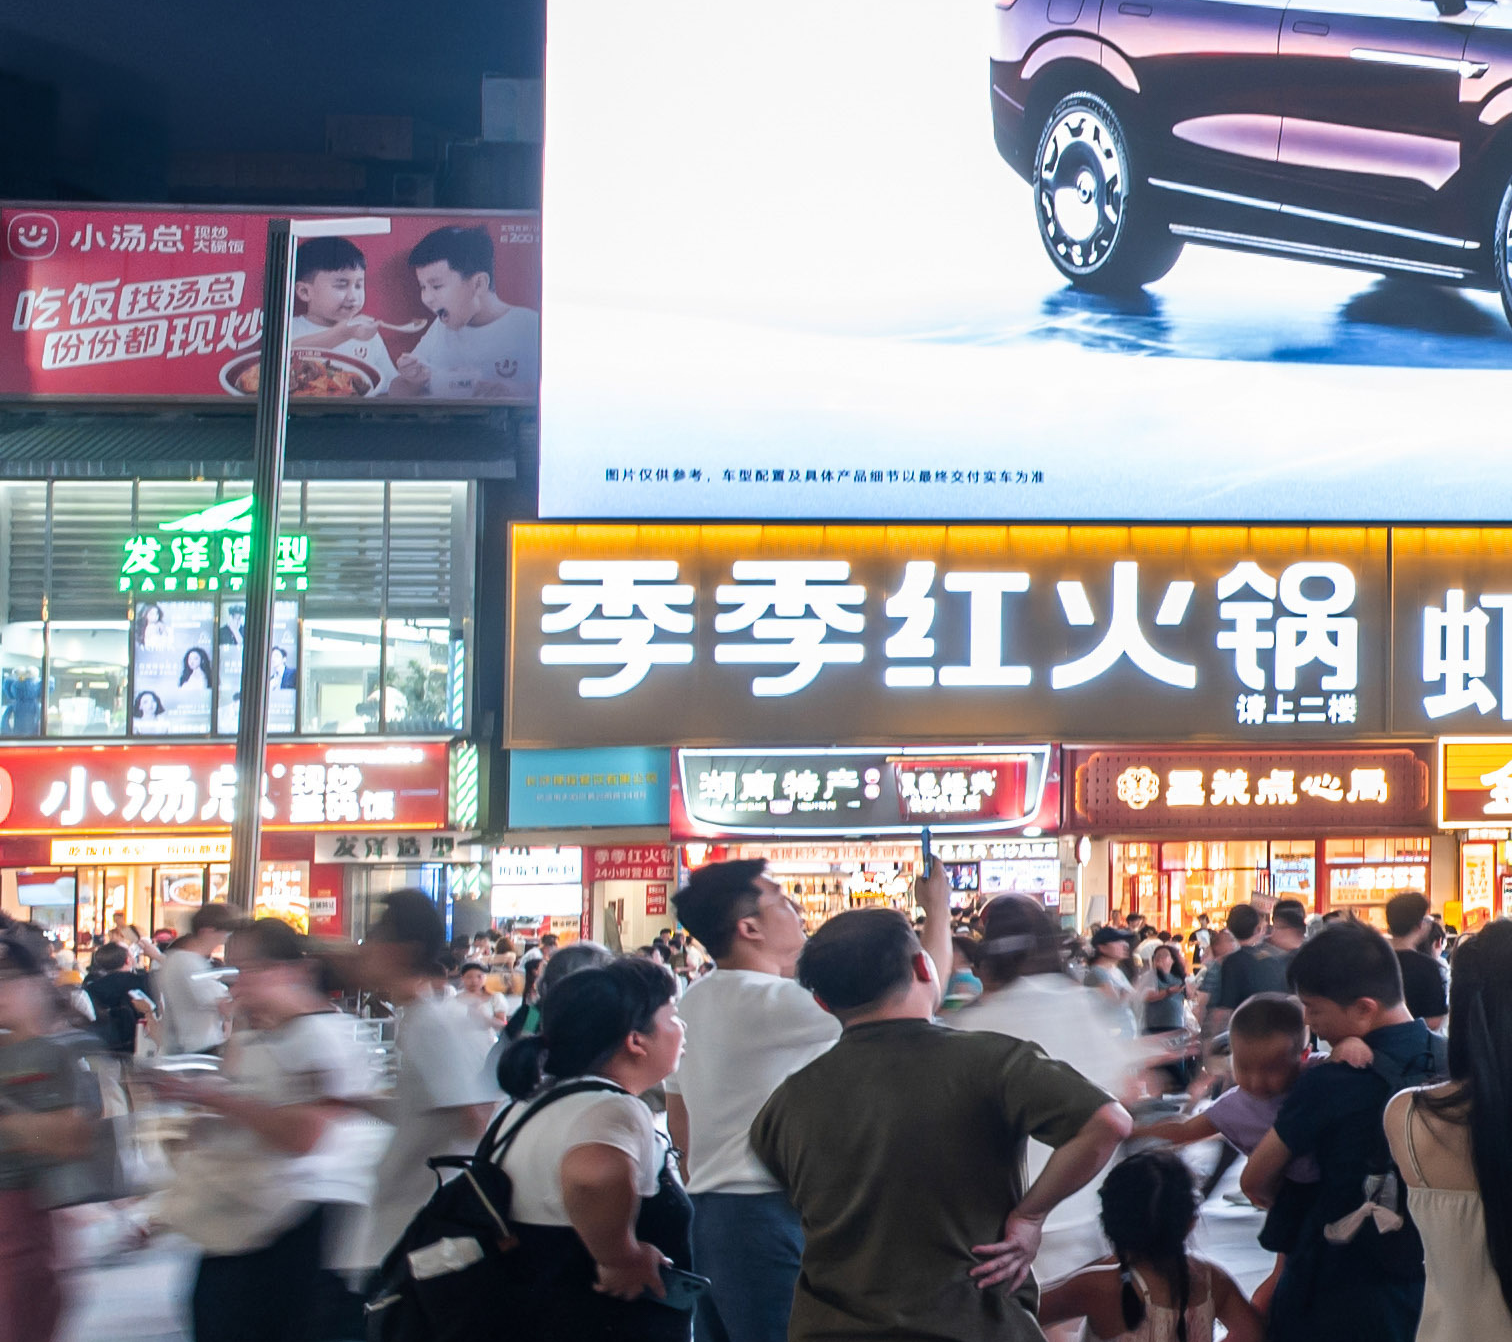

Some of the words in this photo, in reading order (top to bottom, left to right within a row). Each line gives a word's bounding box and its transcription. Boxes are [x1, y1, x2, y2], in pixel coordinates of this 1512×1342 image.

[70, 223, 185, 254] 小汤总
[13, 273, 241, 332] 吃饭找汤总
[49, 313, 264, 364] 份份都现炒
[540, 559, 1358, 698] 季季红火锅
[1236, 693, 1358, 725] 请上二楼
[699, 767, 860, 802] 湖南特产
[333, 835, 457, 858] 发洋造型
